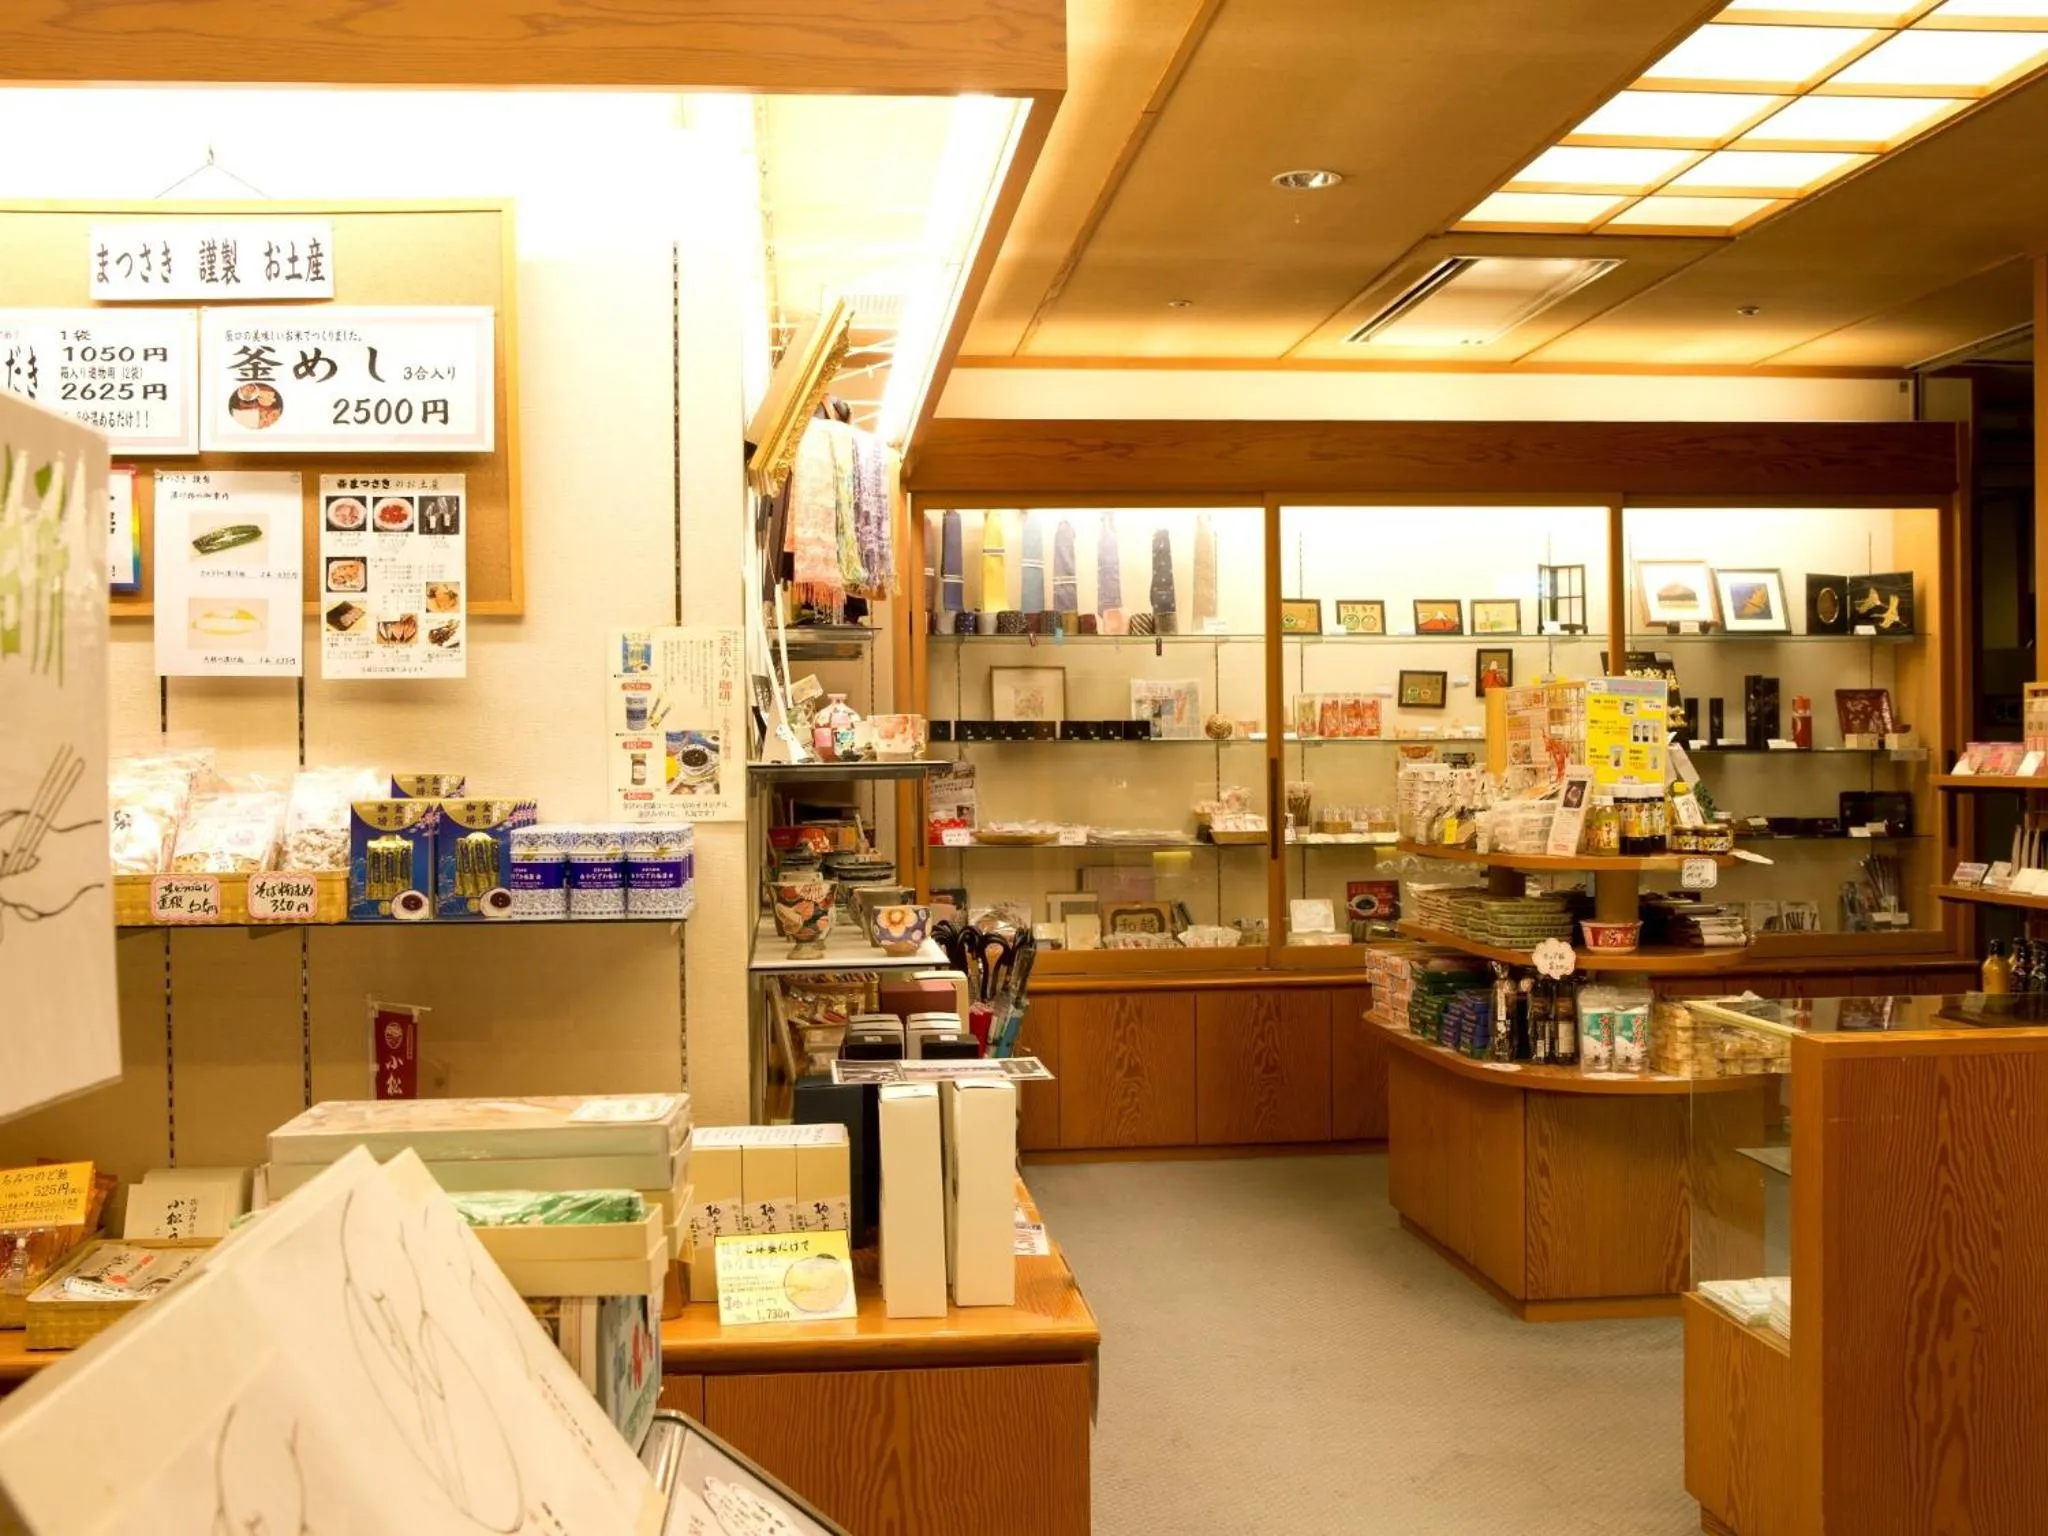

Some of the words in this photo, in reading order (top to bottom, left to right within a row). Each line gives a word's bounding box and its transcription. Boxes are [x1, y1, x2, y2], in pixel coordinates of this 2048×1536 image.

[95, 241, 173, 284] まつさき
[199, 240, 241, 285] 謹製
[264, 237, 326, 284] お土産
[62, 346, 168, 362] 1050円
[227, 345, 386, 383] 釜めし
[403, 366, 457, 381] 3合入り
[61, 383, 168, 400] 2625円
[332, 398, 449, 425] 2500円
[271, 900, 309, 913] 350円
[385, 1055, 404, 1097] 小松
[34, 1182, 70, 1197] 525円
